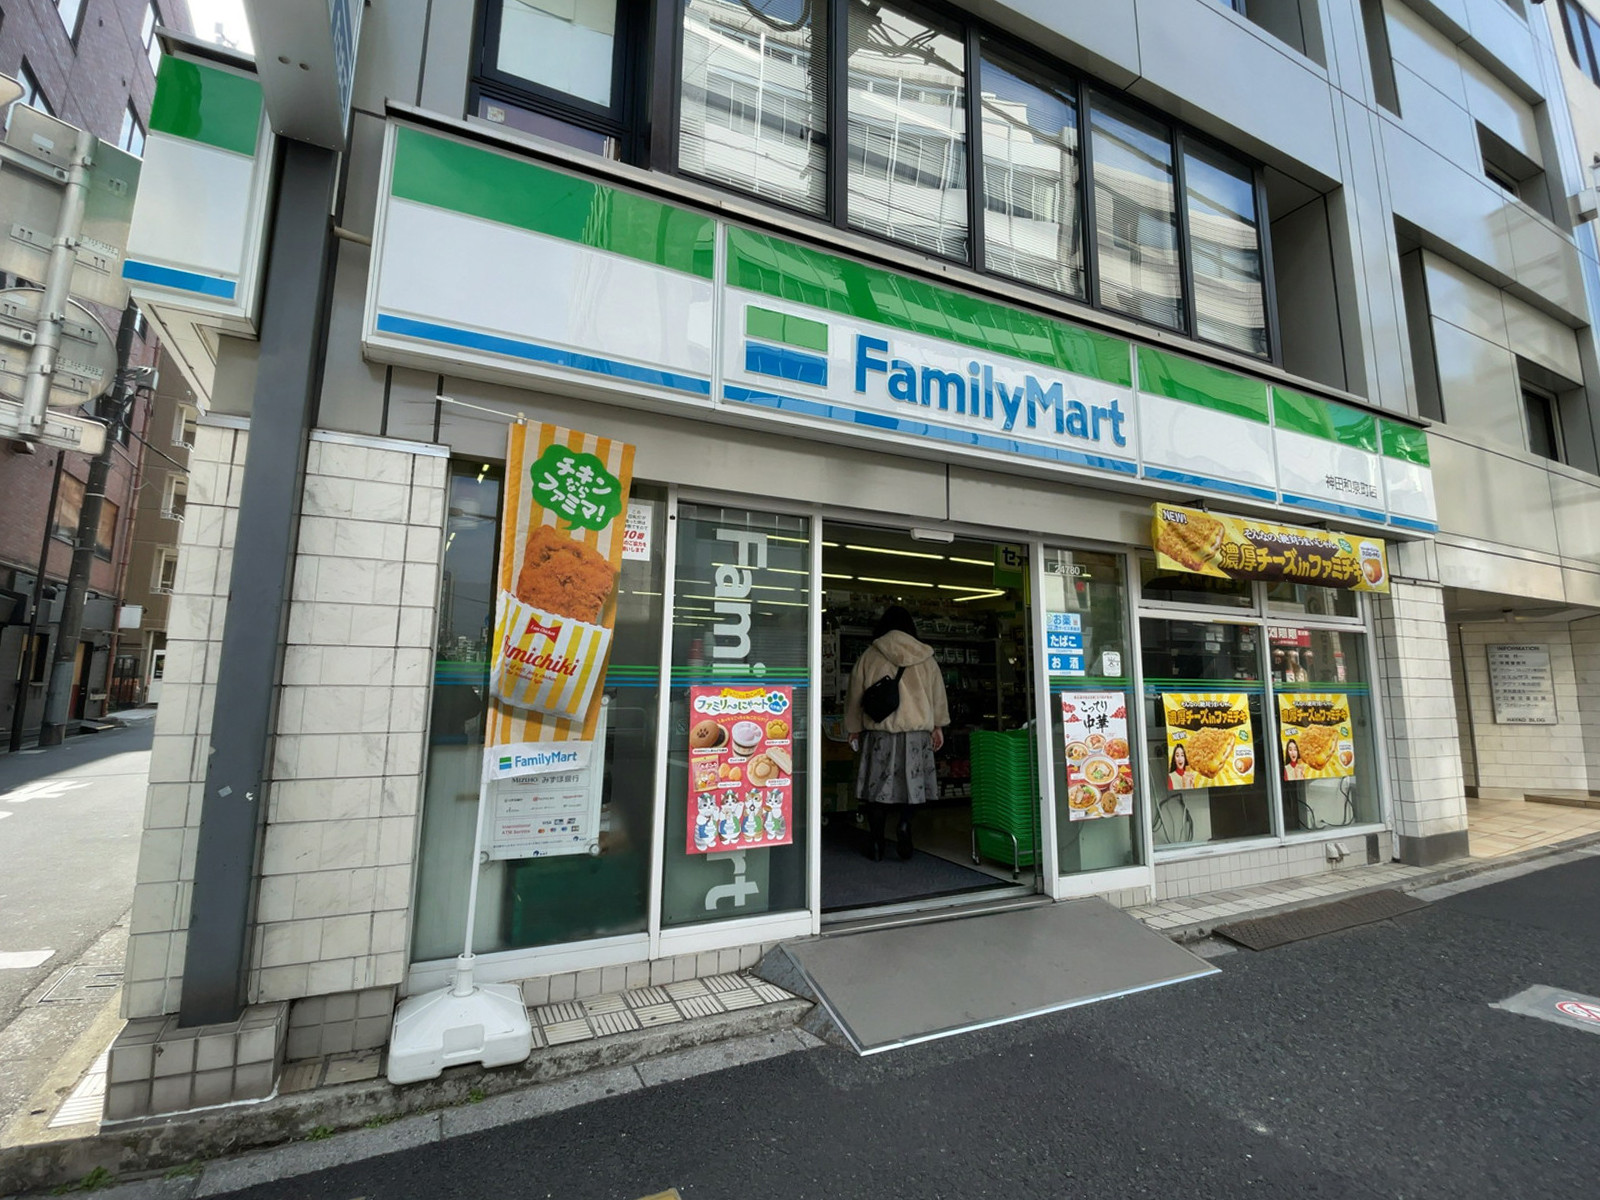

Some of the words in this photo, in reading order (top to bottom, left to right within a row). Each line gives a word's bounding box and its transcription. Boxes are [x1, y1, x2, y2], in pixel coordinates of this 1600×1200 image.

[853, 333, 1127, 447] FamilyMart
[556, 457, 612, 495] チキン
[565, 477, 590, 498] なら
[538, 472, 605, 522] ファミマ!
[1162, 509, 1188, 525] NEW!
[1054, 564, 1081, 576] 24780
[1219, 542, 1364, 584] 濃厚チーズinファミチキ
[1053, 614, 1072, 626] お薬
[1050, 634, 1077, 648] たばこ
[1051, 656, 1080, 670] お酒
[1081, 700, 1108, 713] こってり
[1083, 713, 1110, 734] 中華
[1167, 708, 1248, 725] 濃厚チーズinファミチキ
[514, 751, 578, 768] FamilyMart
[541, 774, 580, 784] みずほ銀行
